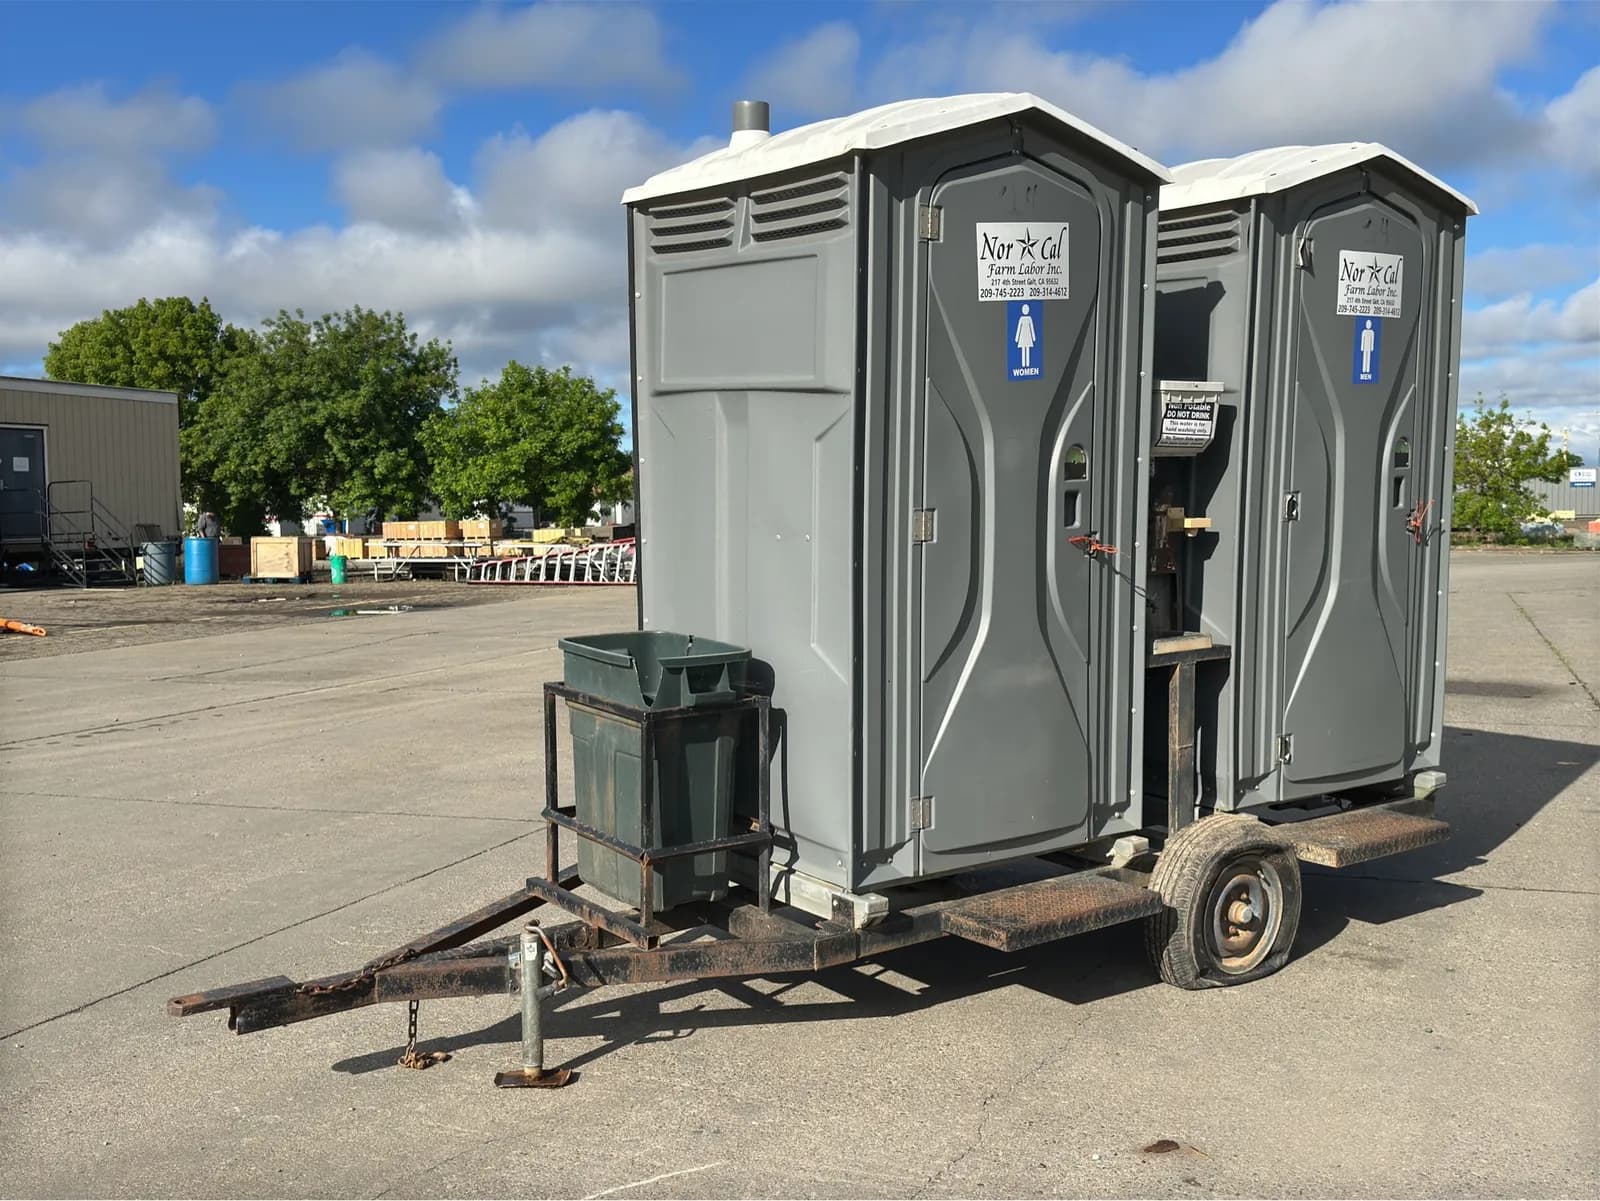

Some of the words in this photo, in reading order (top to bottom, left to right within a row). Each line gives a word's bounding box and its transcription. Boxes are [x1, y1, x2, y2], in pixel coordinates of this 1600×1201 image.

[980, 232, 1013, 260] Nor
[1041, 227, 1067, 260] Cal
[986, 263, 1016, 278] Farm
[1017, 261, 1046, 275] Labor
[1046, 263, 1063, 275] Inc.
[1340, 258, 1365, 283] Nor
[1384, 258, 1402, 284] Cal
[1012, 278, 1026, 286] Street
[980, 288, 1025, 298] 209-745-2223
[1029, 287, 1068, 297] 209-314-4612
[1344, 284, 1365, 297] Farm
[1366, 285, 1387, 297] Labor
[1012, 367, 1040, 377] WOMEN
[1191, 411, 1210, 420] DRINK
